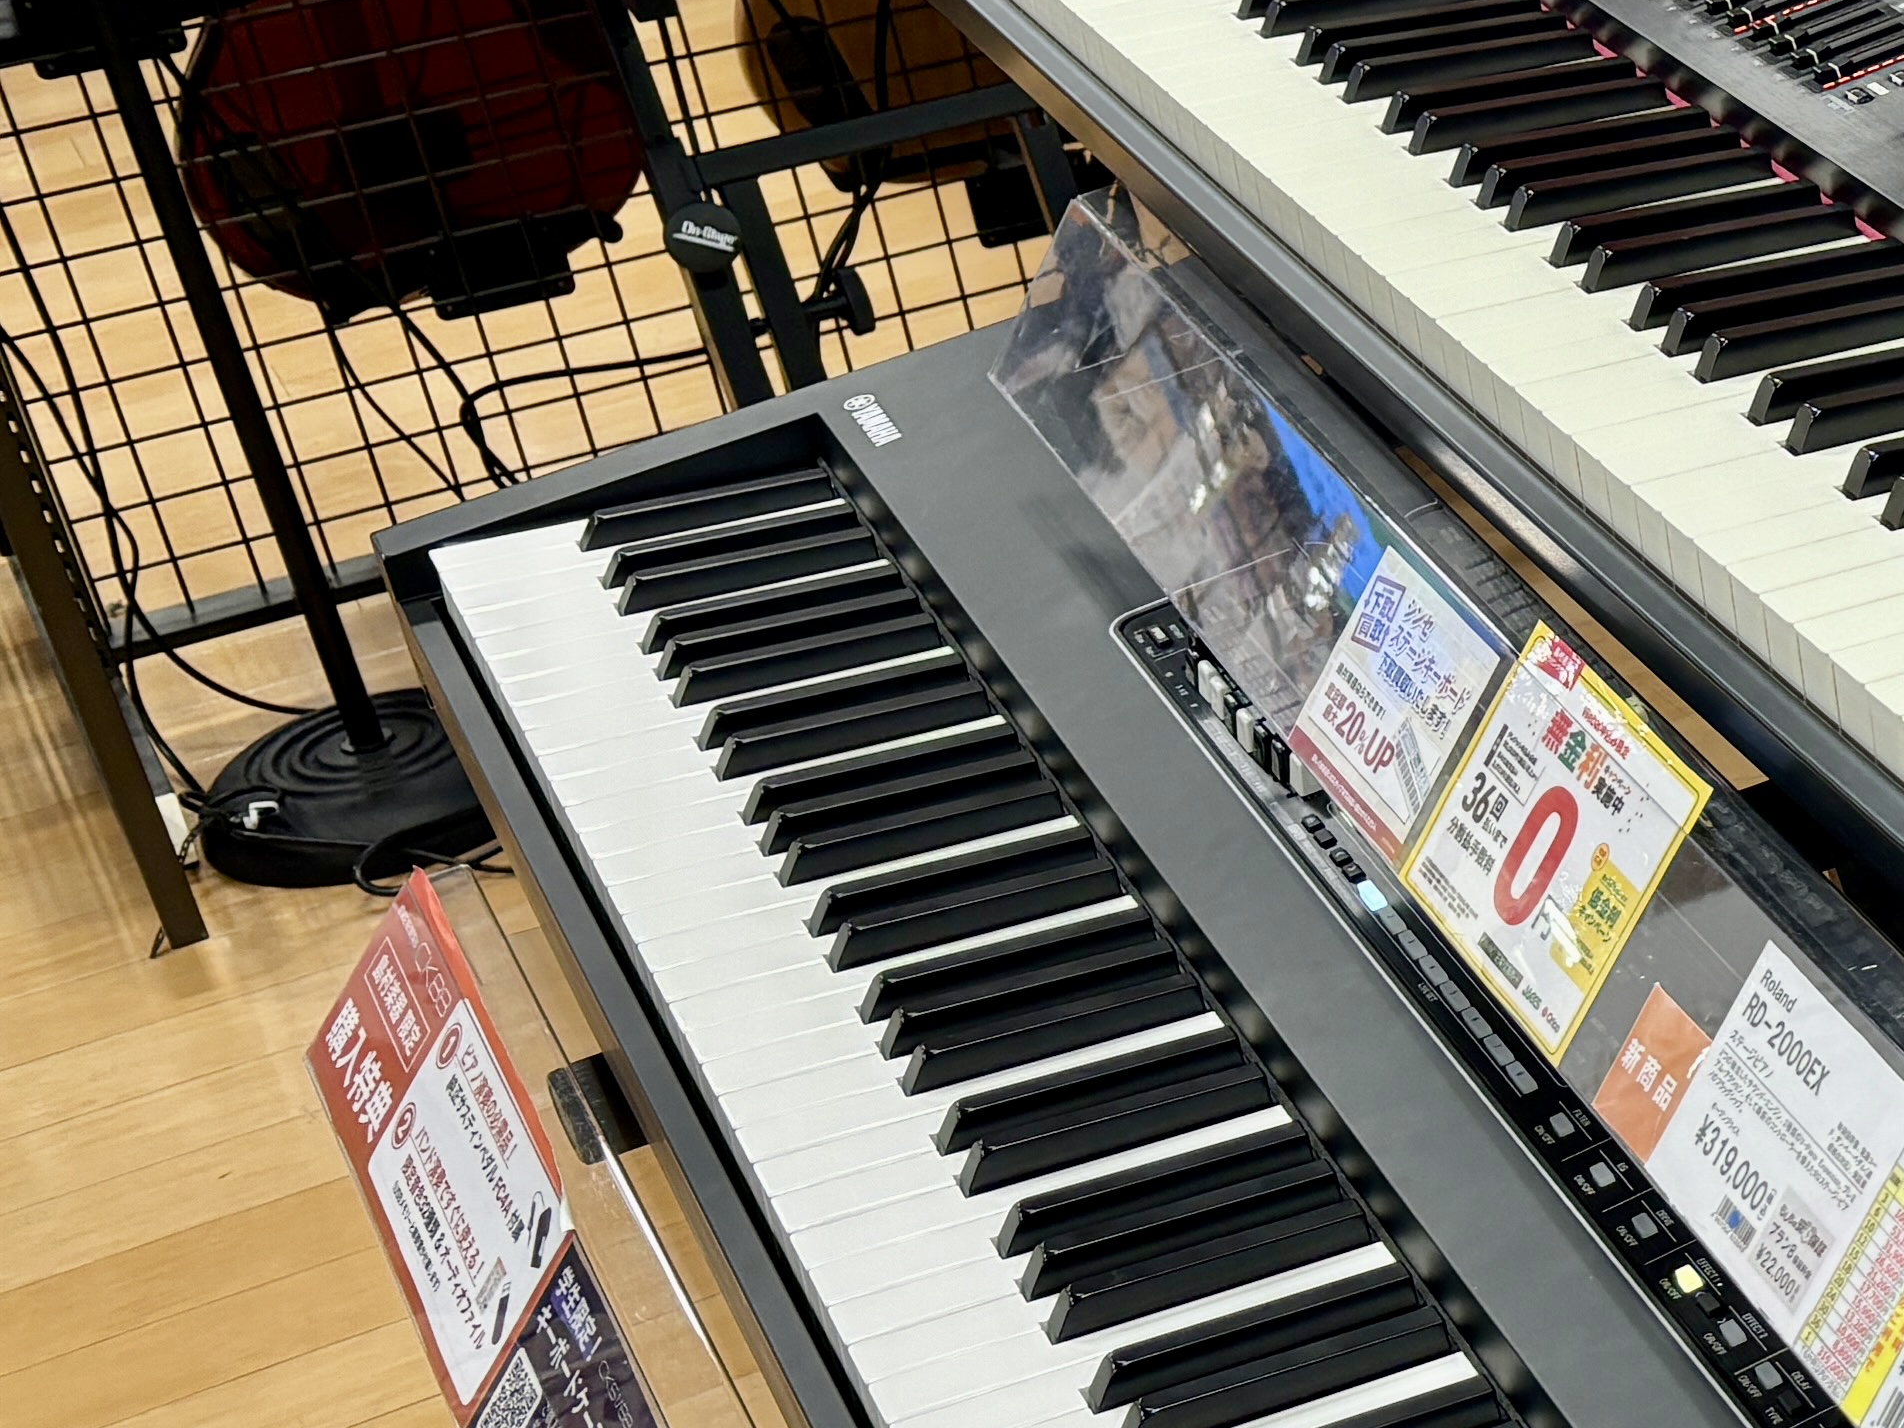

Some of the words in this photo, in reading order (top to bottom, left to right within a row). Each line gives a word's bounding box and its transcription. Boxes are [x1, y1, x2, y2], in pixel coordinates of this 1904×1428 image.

[850, 399, 903, 449] YAMAHA
[1401, 596, 1436, 643] シンセ
[1387, 619, 1471, 719] ステージキーボード
[1322, 702, 1339, 727] 最大
[1334, 698, 1397, 781] 20%UP
[1539, 706, 1608, 792] 無金利
[1458, 768, 1510, 838] 36回
[1590, 775, 1625, 819] 実施中
[1445, 813, 1496, 877] 分割払手数料
[1483, 773, 1588, 938] 0
[412, 937, 452, 1022] CK88
[1759, 967, 1797, 1014] Roland
[395, 1005, 422, 1058] 限定
[440, 1030, 457, 1062] 1
[1728, 1027, 1773, 1081] ステージピアノ
[1740, 990, 1831, 1097] RD-2000EX
[322, 993, 396, 1147] 購入特典
[1618, 1035, 1679, 1112] 新商品
[396, 1113, 411, 1140] 2
[1691, 1112, 1771, 1215] ¥319,000
[491, 1174, 513, 1220] FC4A
[433, 1230, 445, 1253] &
[1615, 1224, 1640, 1248] ON/OFF
[1657, 1278, 1682, 1301] ON/OFF
[1753, 1240, 1796, 1298] ¥22,000
[436, 1242, 487, 1354] オーディオファイル
[553, 1260, 602, 1368] 学生限定!
[1702, 1330, 1728, 1357] ON/OFF
[1737, 1372, 1763, 1400] ON/OFF
[1790, 1370, 1812, 1395] DELAY
[1764, 1406, 1784, 1427] TYPE
